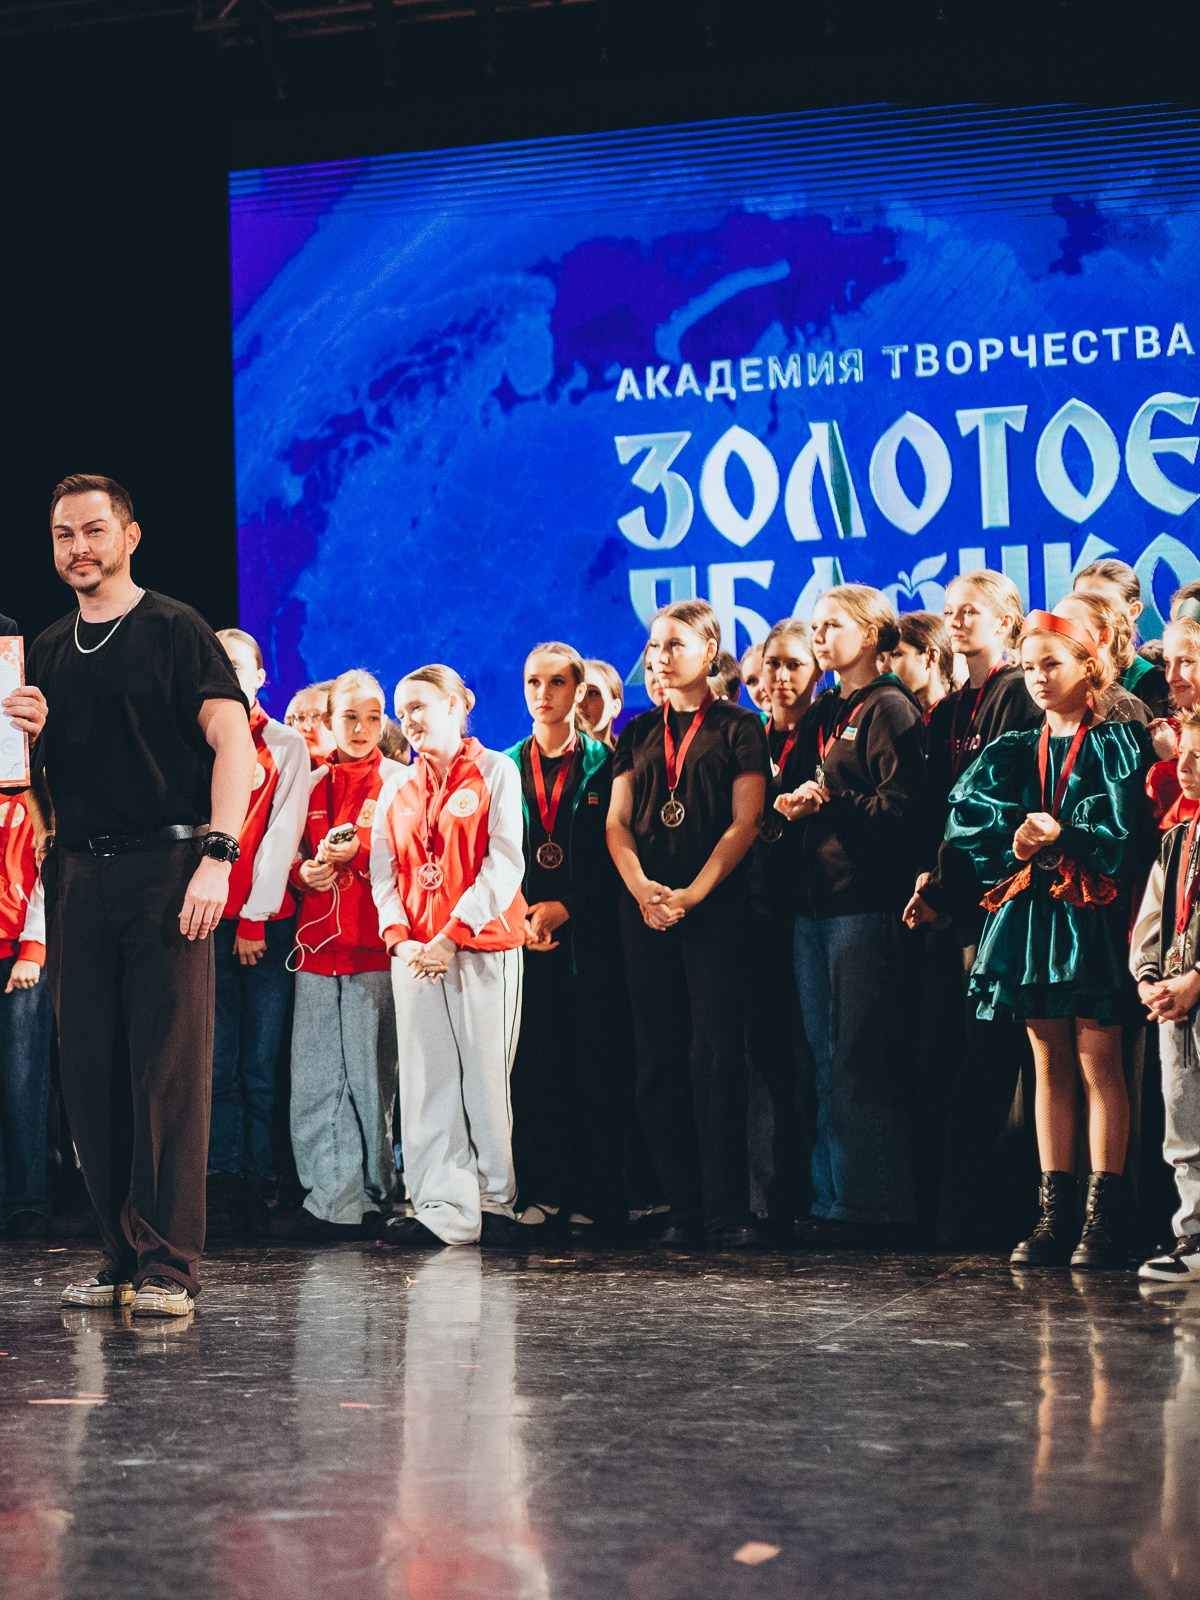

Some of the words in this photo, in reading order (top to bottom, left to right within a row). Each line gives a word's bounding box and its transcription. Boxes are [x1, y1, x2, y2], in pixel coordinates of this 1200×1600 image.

[615, 348, 863, 402] АКАДЕМИЯ
[881, 322, 1196, 380] ТВОРЧЕСТВА
[613, 391, 1200, 550] ЗОЛОТОЕ
